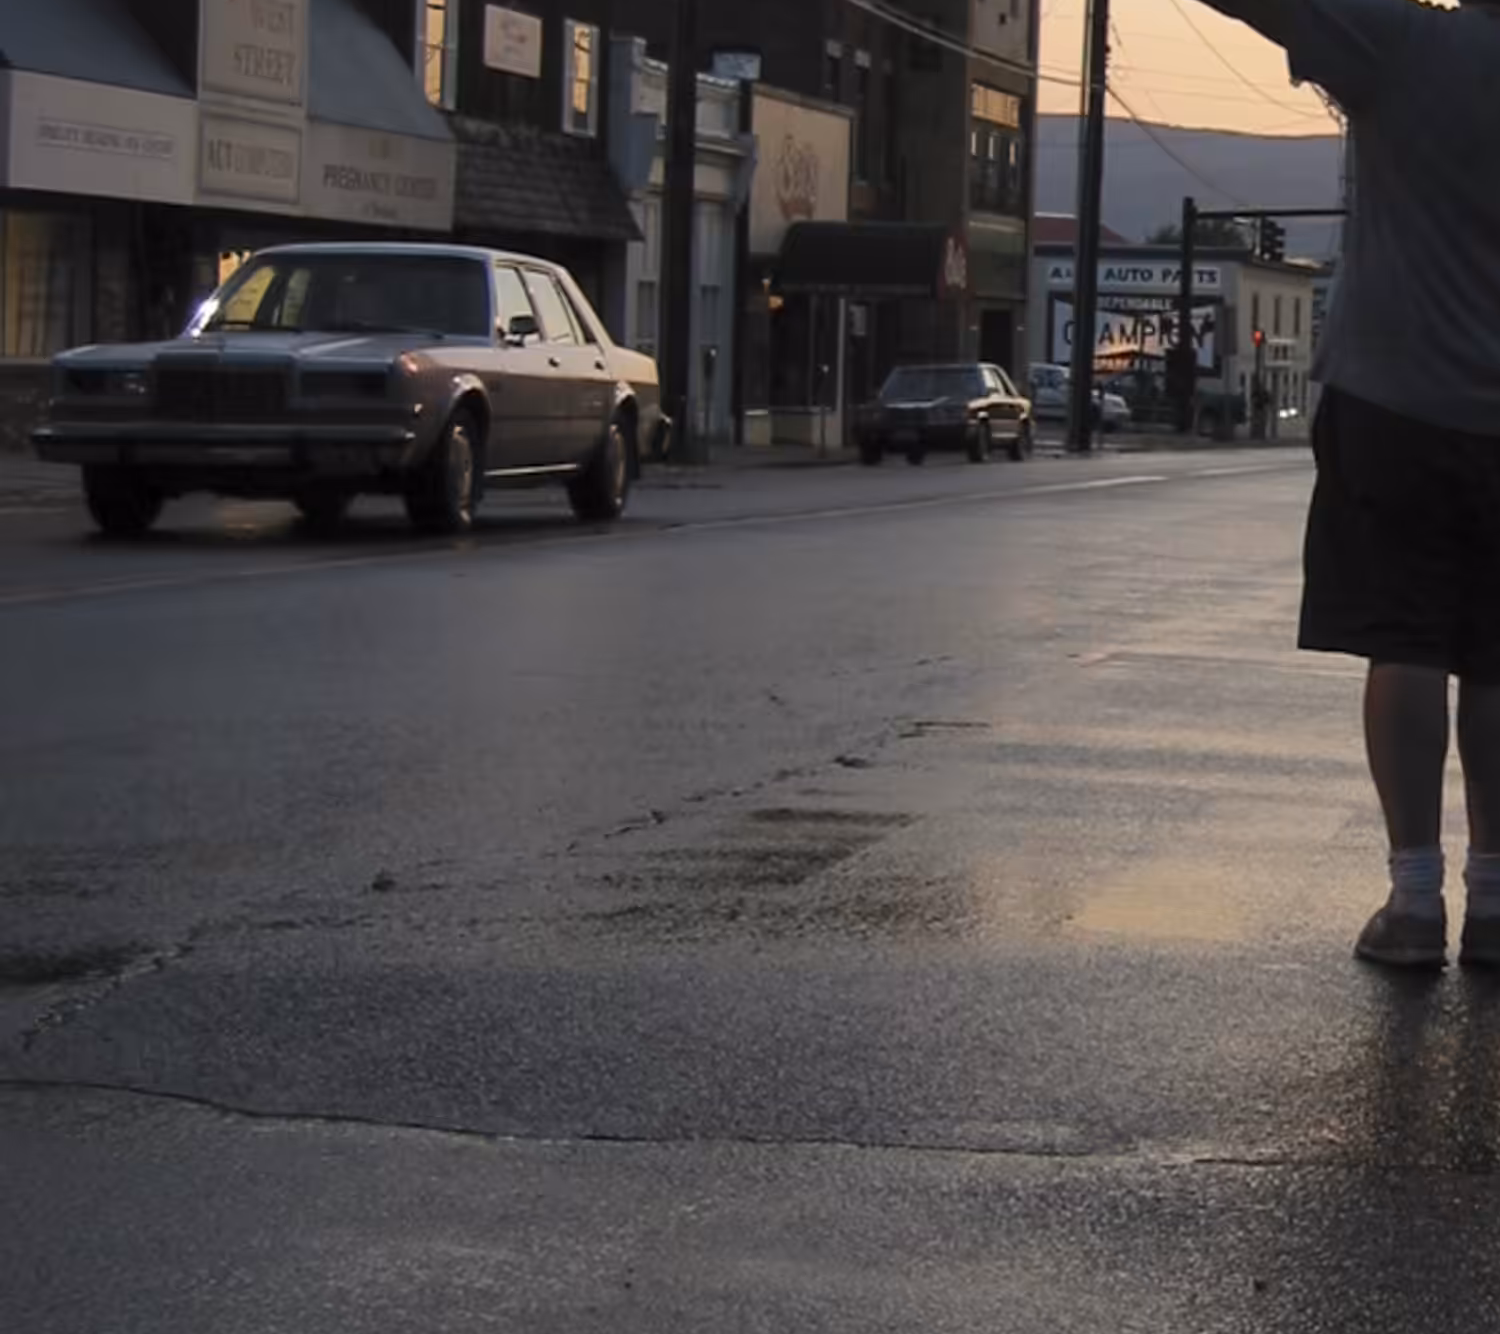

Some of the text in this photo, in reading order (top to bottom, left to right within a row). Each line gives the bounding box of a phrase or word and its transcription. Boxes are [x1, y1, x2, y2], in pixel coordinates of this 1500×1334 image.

[1104, 268, 1153, 282] AUTO
[1160, 269, 1218, 284] PATS
[1063, 315, 1207, 348] CAMPION
